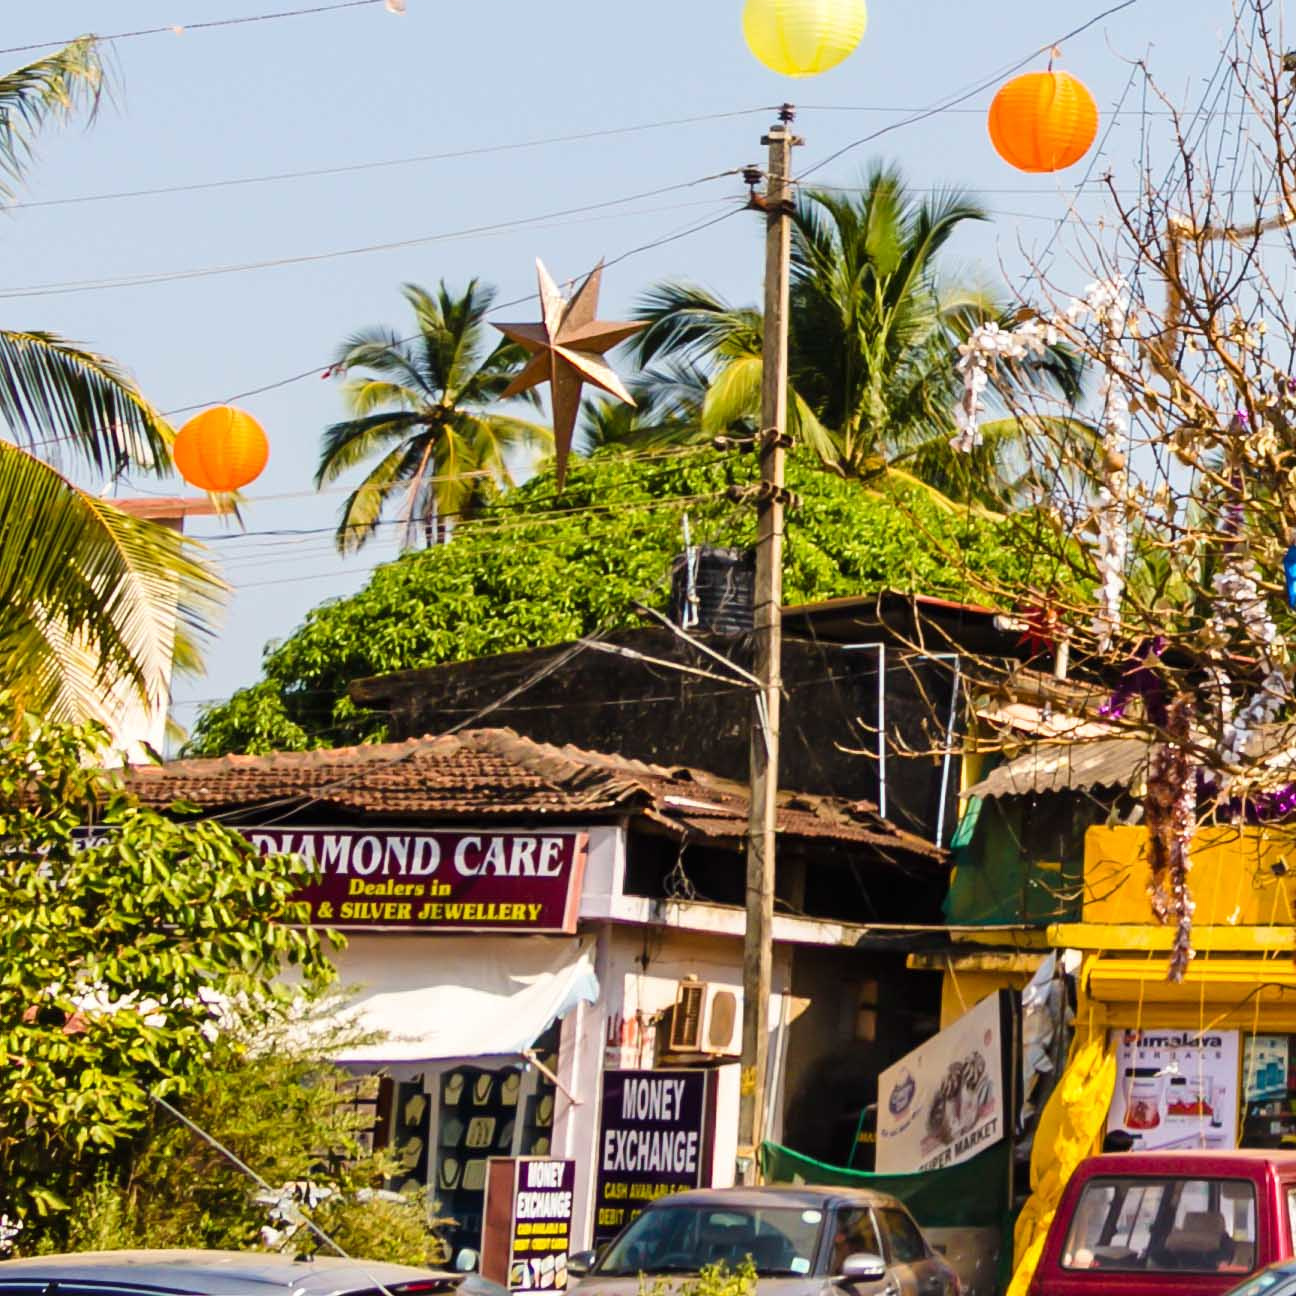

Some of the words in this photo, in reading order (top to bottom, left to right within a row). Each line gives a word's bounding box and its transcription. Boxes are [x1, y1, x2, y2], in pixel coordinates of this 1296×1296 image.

[251, 834, 441, 876] DIAMOND
[453, 836, 565, 877] CARE
[349, 878, 424, 897] Dealers
[431, 878, 452, 897] in
[317, 901, 333, 918] &
[340, 901, 411, 921] SILVER
[418, 902, 543, 921] JEWELLERY
[622, 1078, 685, 1120] MONEY
[955, 1118, 998, 1157] MARKET
[603, 1130, 698, 1173] EXCHANGE
[527, 1161, 566, 1188] MONEY
[604, 1182, 628, 1199] CASH
[516, 1192, 572, 1218] EXCHANGE
